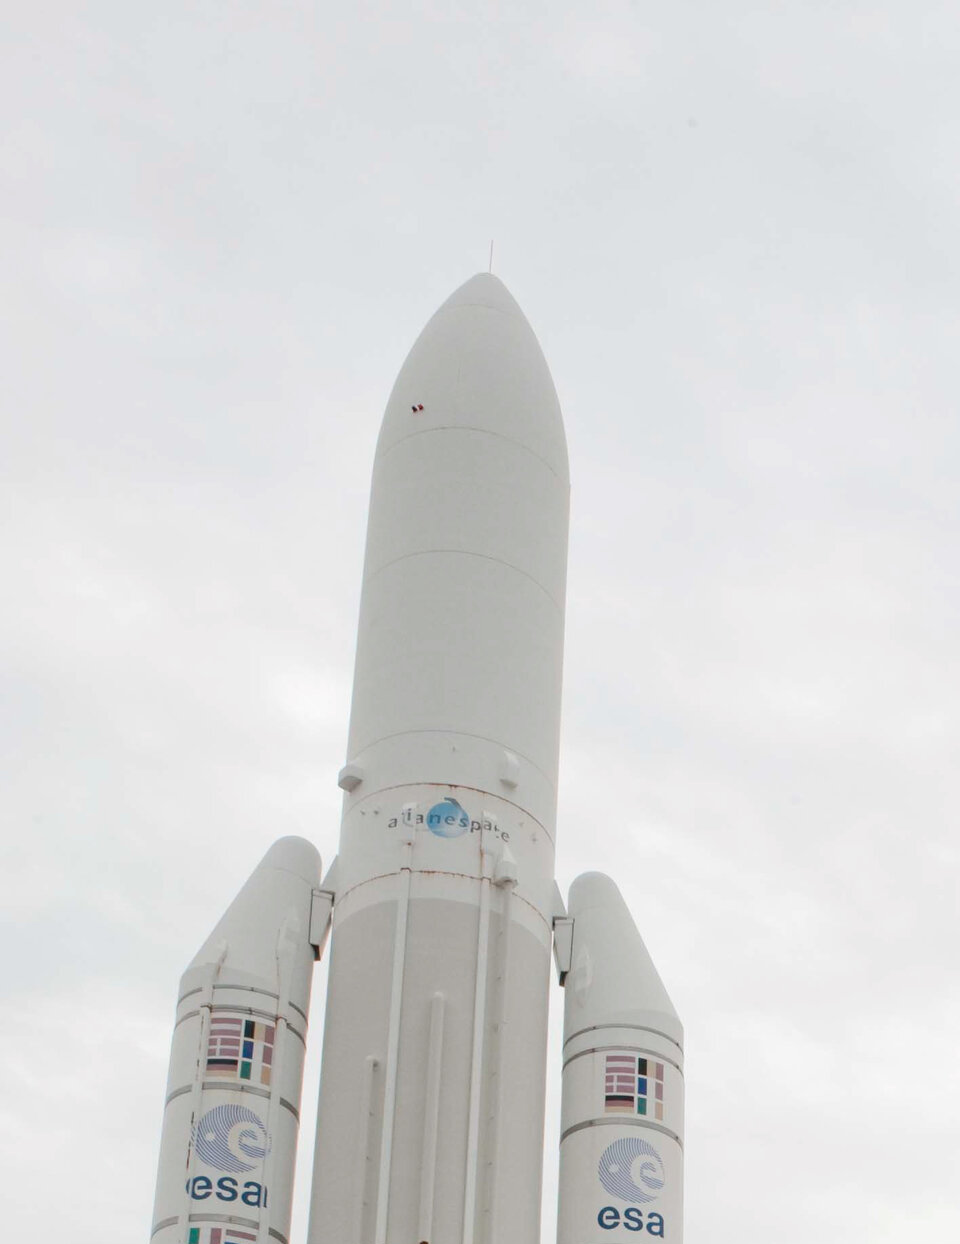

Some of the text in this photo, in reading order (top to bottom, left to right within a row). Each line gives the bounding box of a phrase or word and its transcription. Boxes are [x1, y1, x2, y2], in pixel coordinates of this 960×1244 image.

[388, 807, 510, 843] aianespae
[186, 1176, 268, 1208] esa
[597, 1206, 664, 1238] esa
